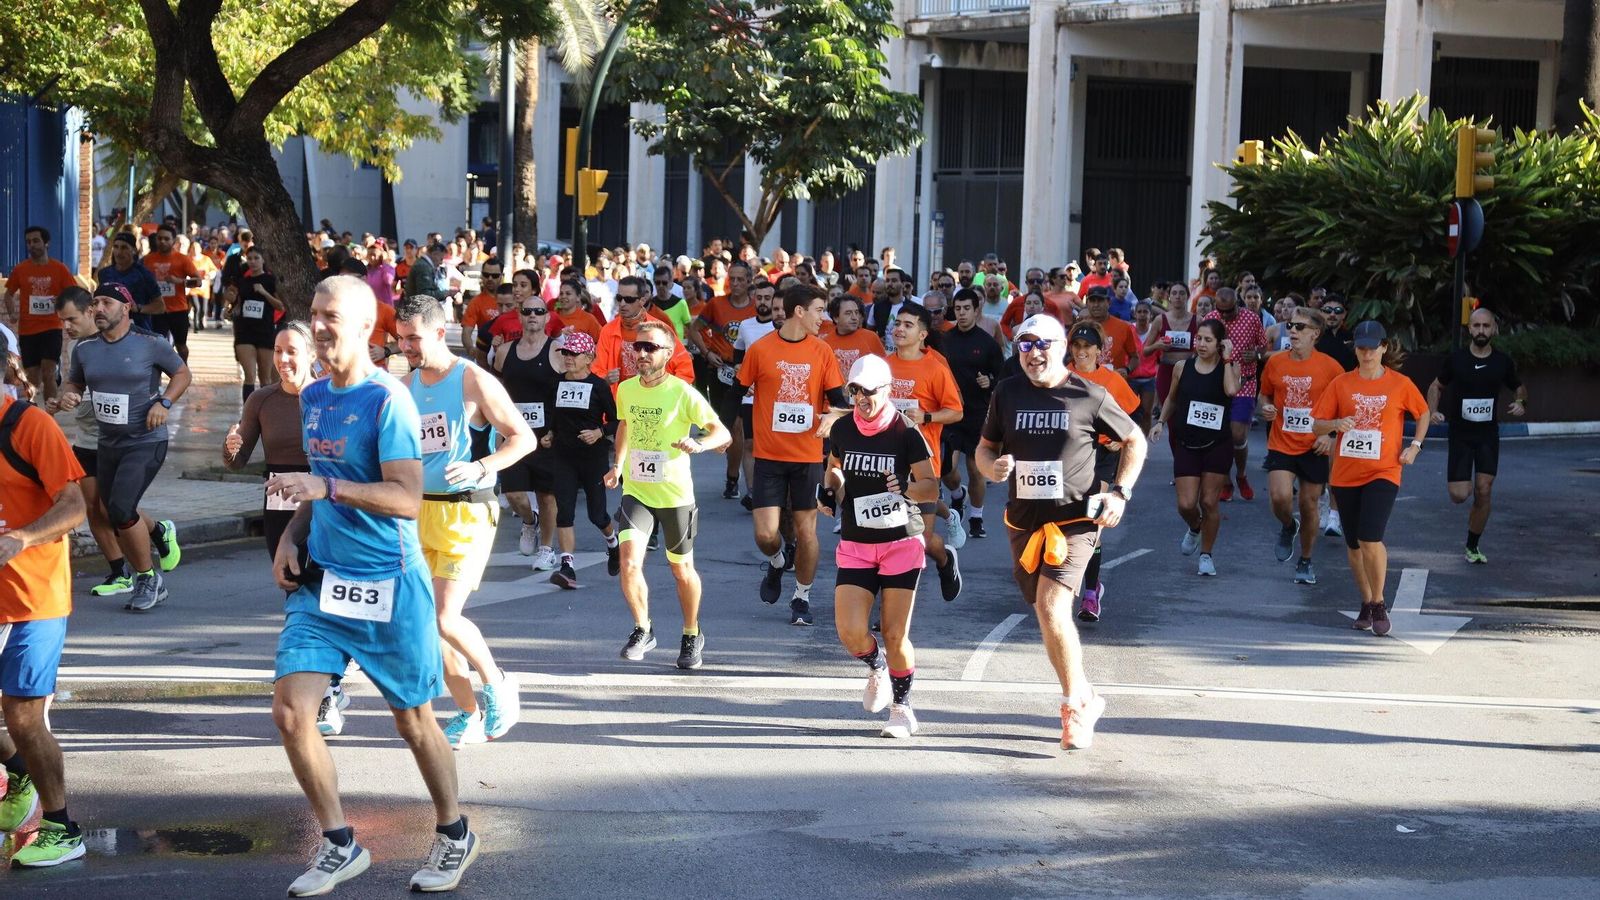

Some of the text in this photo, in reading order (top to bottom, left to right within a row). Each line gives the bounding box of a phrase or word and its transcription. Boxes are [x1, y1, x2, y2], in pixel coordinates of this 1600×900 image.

[561, 390, 584, 400] 211
[97, 402, 120, 415] 766
[1467, 406, 1491, 414] 1020
[779, 412, 806, 425] 948
[1016, 412, 1069, 431] FITCLUB
[1194, 410, 1217, 421] 595
[1287, 416, 1310, 426] 276
[1346, 439, 1373, 451] 421
[638, 461, 657, 474] 14
[843, 453, 895, 474] FITCLUB
[854, 470, 880, 478] MALAGA
[1020, 474, 1057, 487] 1086
[862, 501, 902, 520] 1054
[331, 584, 380, 605] 963
